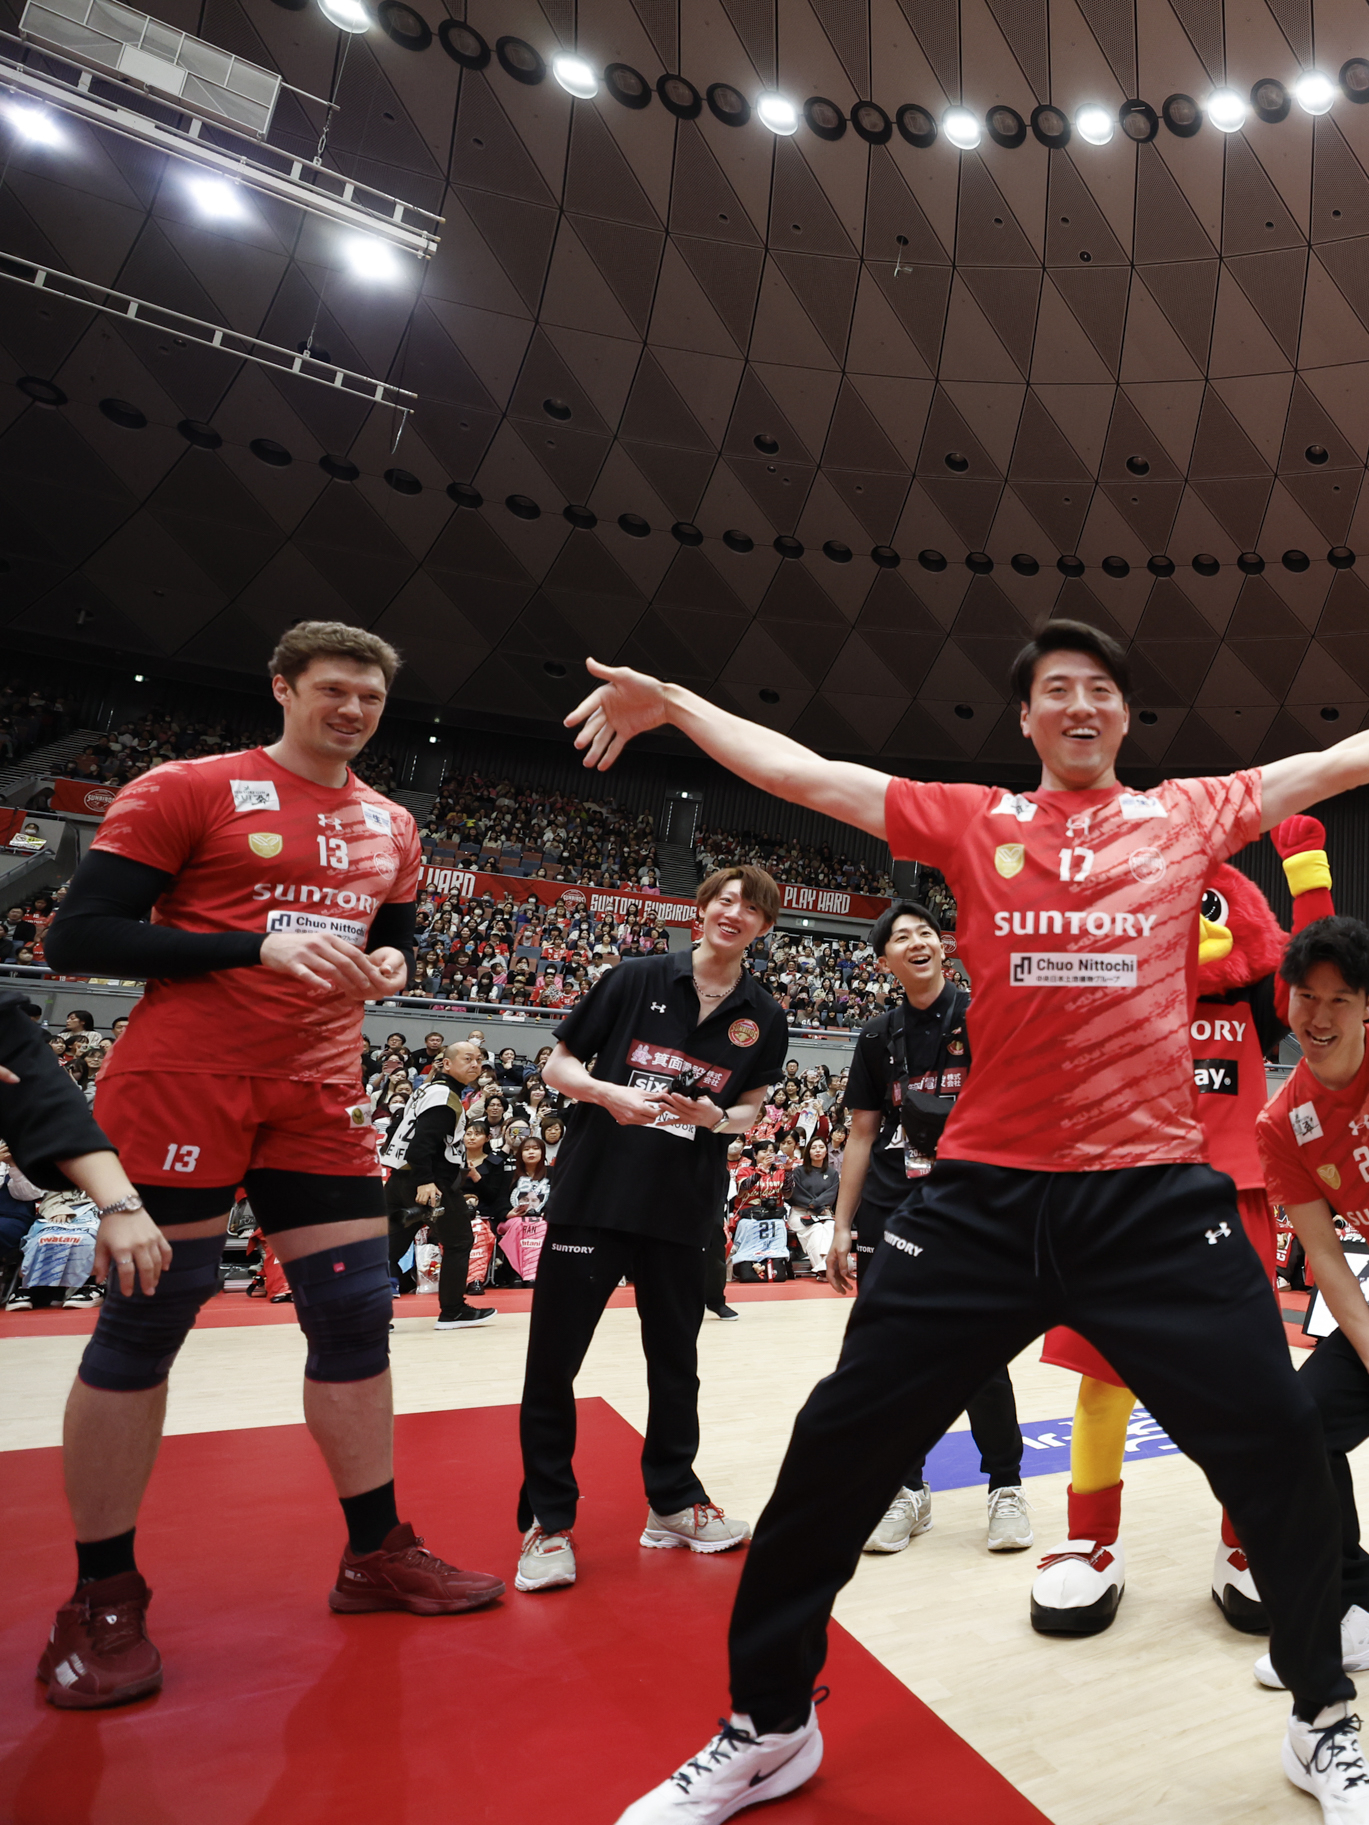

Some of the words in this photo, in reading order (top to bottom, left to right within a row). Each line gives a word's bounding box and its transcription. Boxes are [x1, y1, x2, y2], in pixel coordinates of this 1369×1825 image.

[316, 834, 349, 870] 13
[1058, 846, 1094, 882] 17
[252, 883, 380, 914] SUNTORY
[783, 886, 816, 909] PLAY
[817, 890, 850, 914] HARD
[296, 916, 327, 929] Chuo
[994, 910, 1157, 938] SUNTORY
[1036, 958, 1073, 972] Chuo
[1078, 959, 1134, 972] Nittochi
[702, 1078, 720, 1087] 会社
[162, 1142, 200, 1172] 13
[523, 1226, 536, 1234] RAN
[759, 1222, 776, 1240] 21
[552, 1242, 594, 1254] SUNTORY
